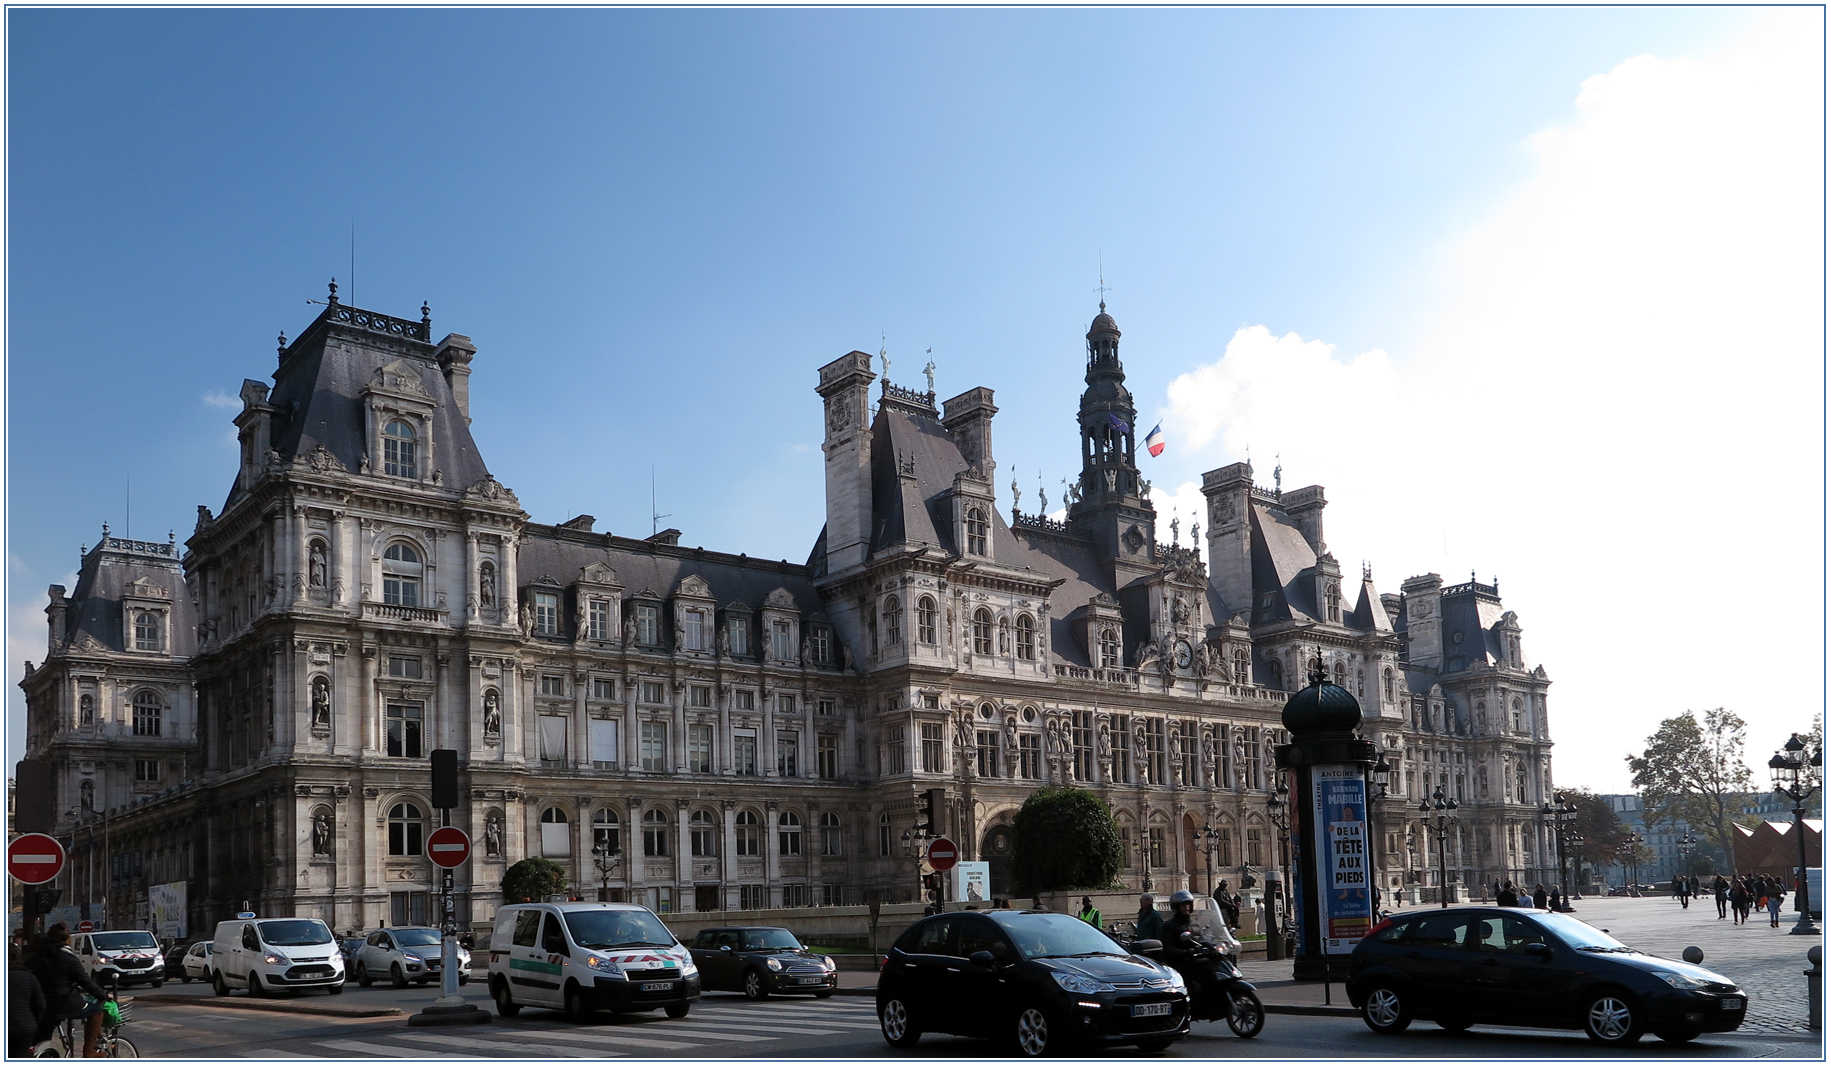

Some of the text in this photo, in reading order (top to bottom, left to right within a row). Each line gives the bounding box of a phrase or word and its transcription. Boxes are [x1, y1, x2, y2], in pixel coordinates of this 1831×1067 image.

[1332, 785, 1359, 793] BERNARD
[1327, 794, 1362, 805] MABILLE
[1336, 827, 1359, 836] DE LA
[1333, 837, 1362, 855] TÊTE
[1338, 857, 1361, 869] AUX
[1335, 871, 1364, 884] PIEDS
[1135, 1004, 1167, 1016] DD-170-RT
